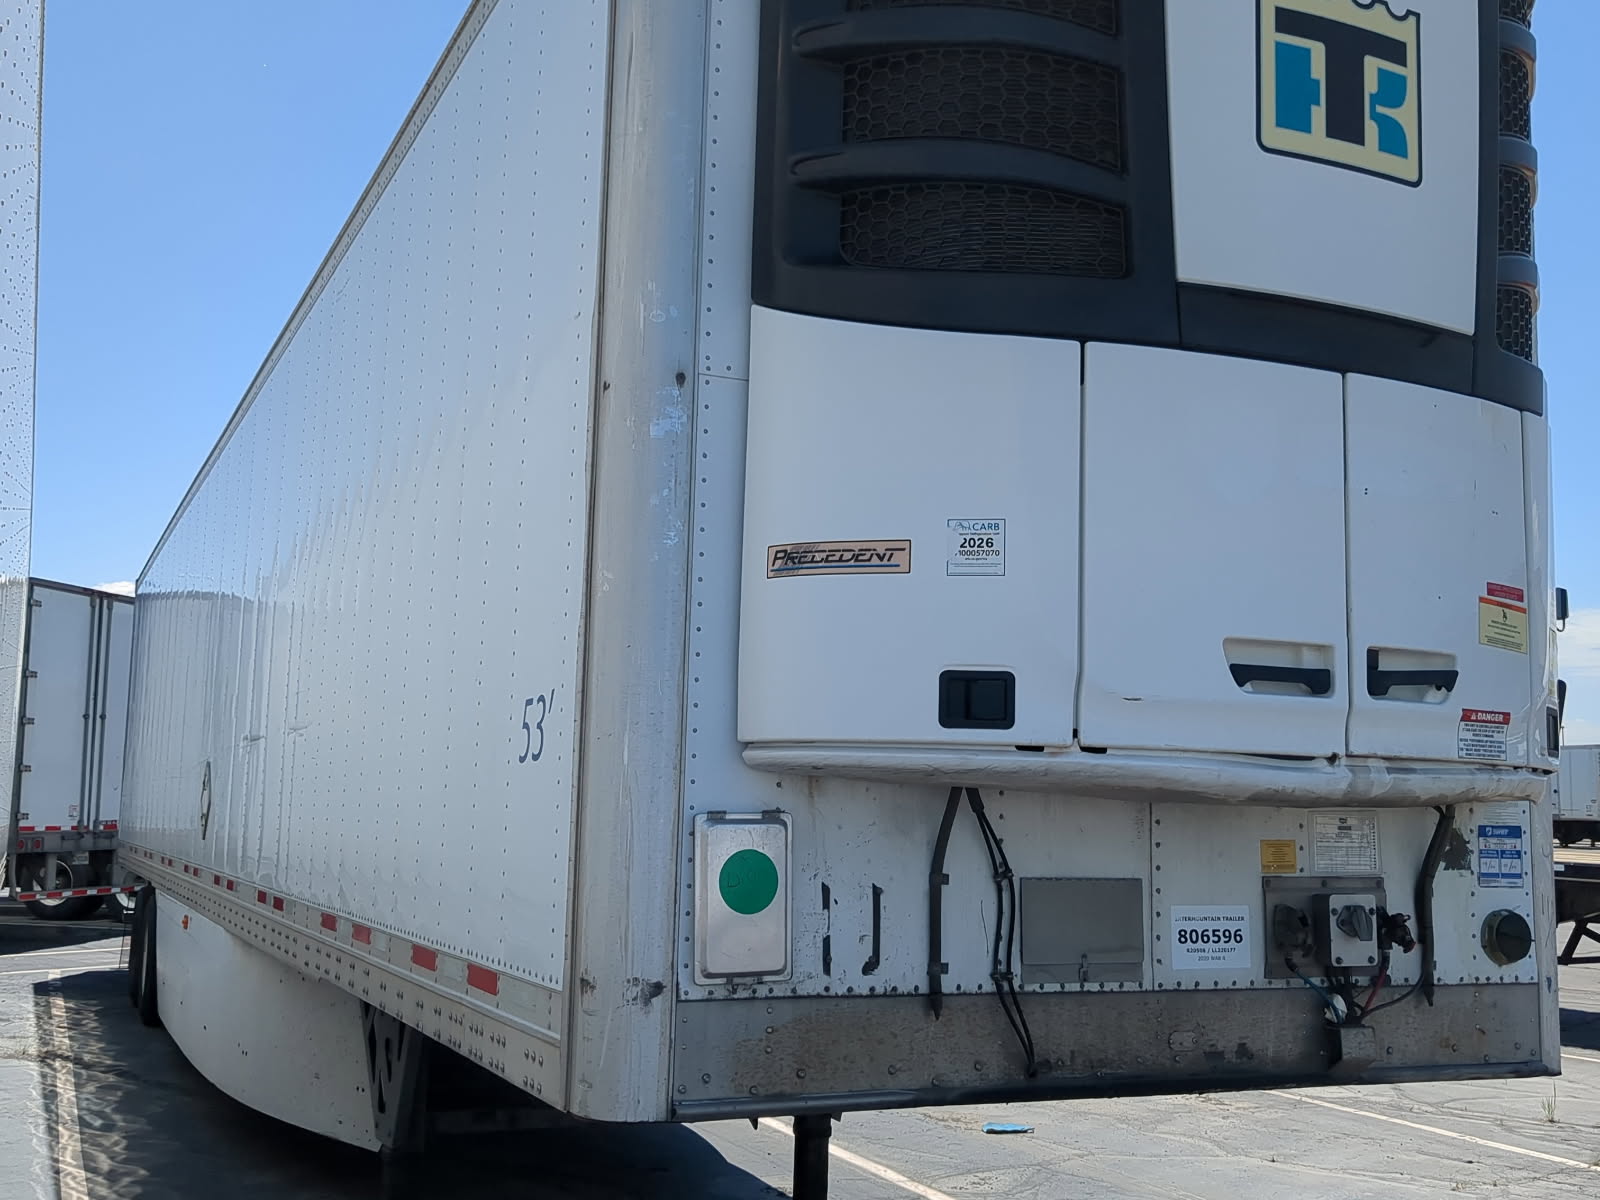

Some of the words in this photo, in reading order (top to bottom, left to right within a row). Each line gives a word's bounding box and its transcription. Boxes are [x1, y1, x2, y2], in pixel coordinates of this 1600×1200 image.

[972, 522, 1000, 531] CARB
[960, 537, 994, 549] 2026
[772, 547, 906, 567] PRECEDENT
[1477, 712, 1504, 722] DANGER
[1177, 928, 1244, 945] 806596
